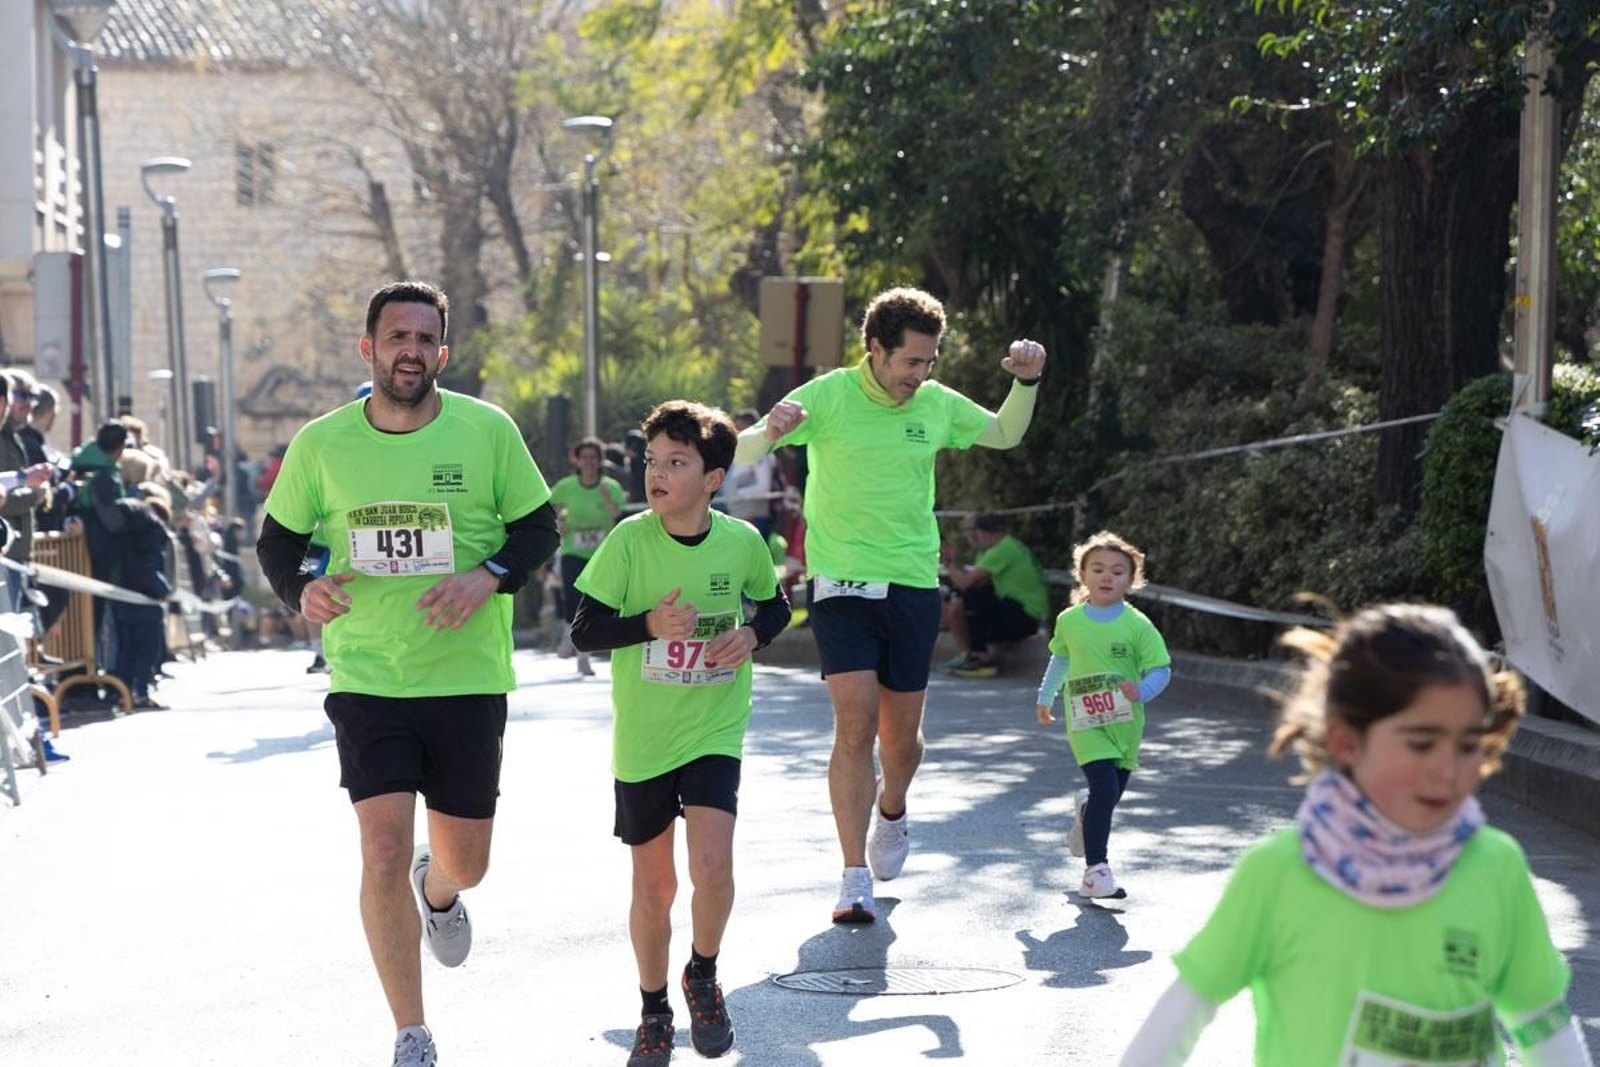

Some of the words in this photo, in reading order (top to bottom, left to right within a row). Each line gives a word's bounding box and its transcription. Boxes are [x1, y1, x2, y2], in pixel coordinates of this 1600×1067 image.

[377, 529, 424, 558] 431
[668, 641, 717, 670] 97
[1082, 691, 1114, 715] 960
